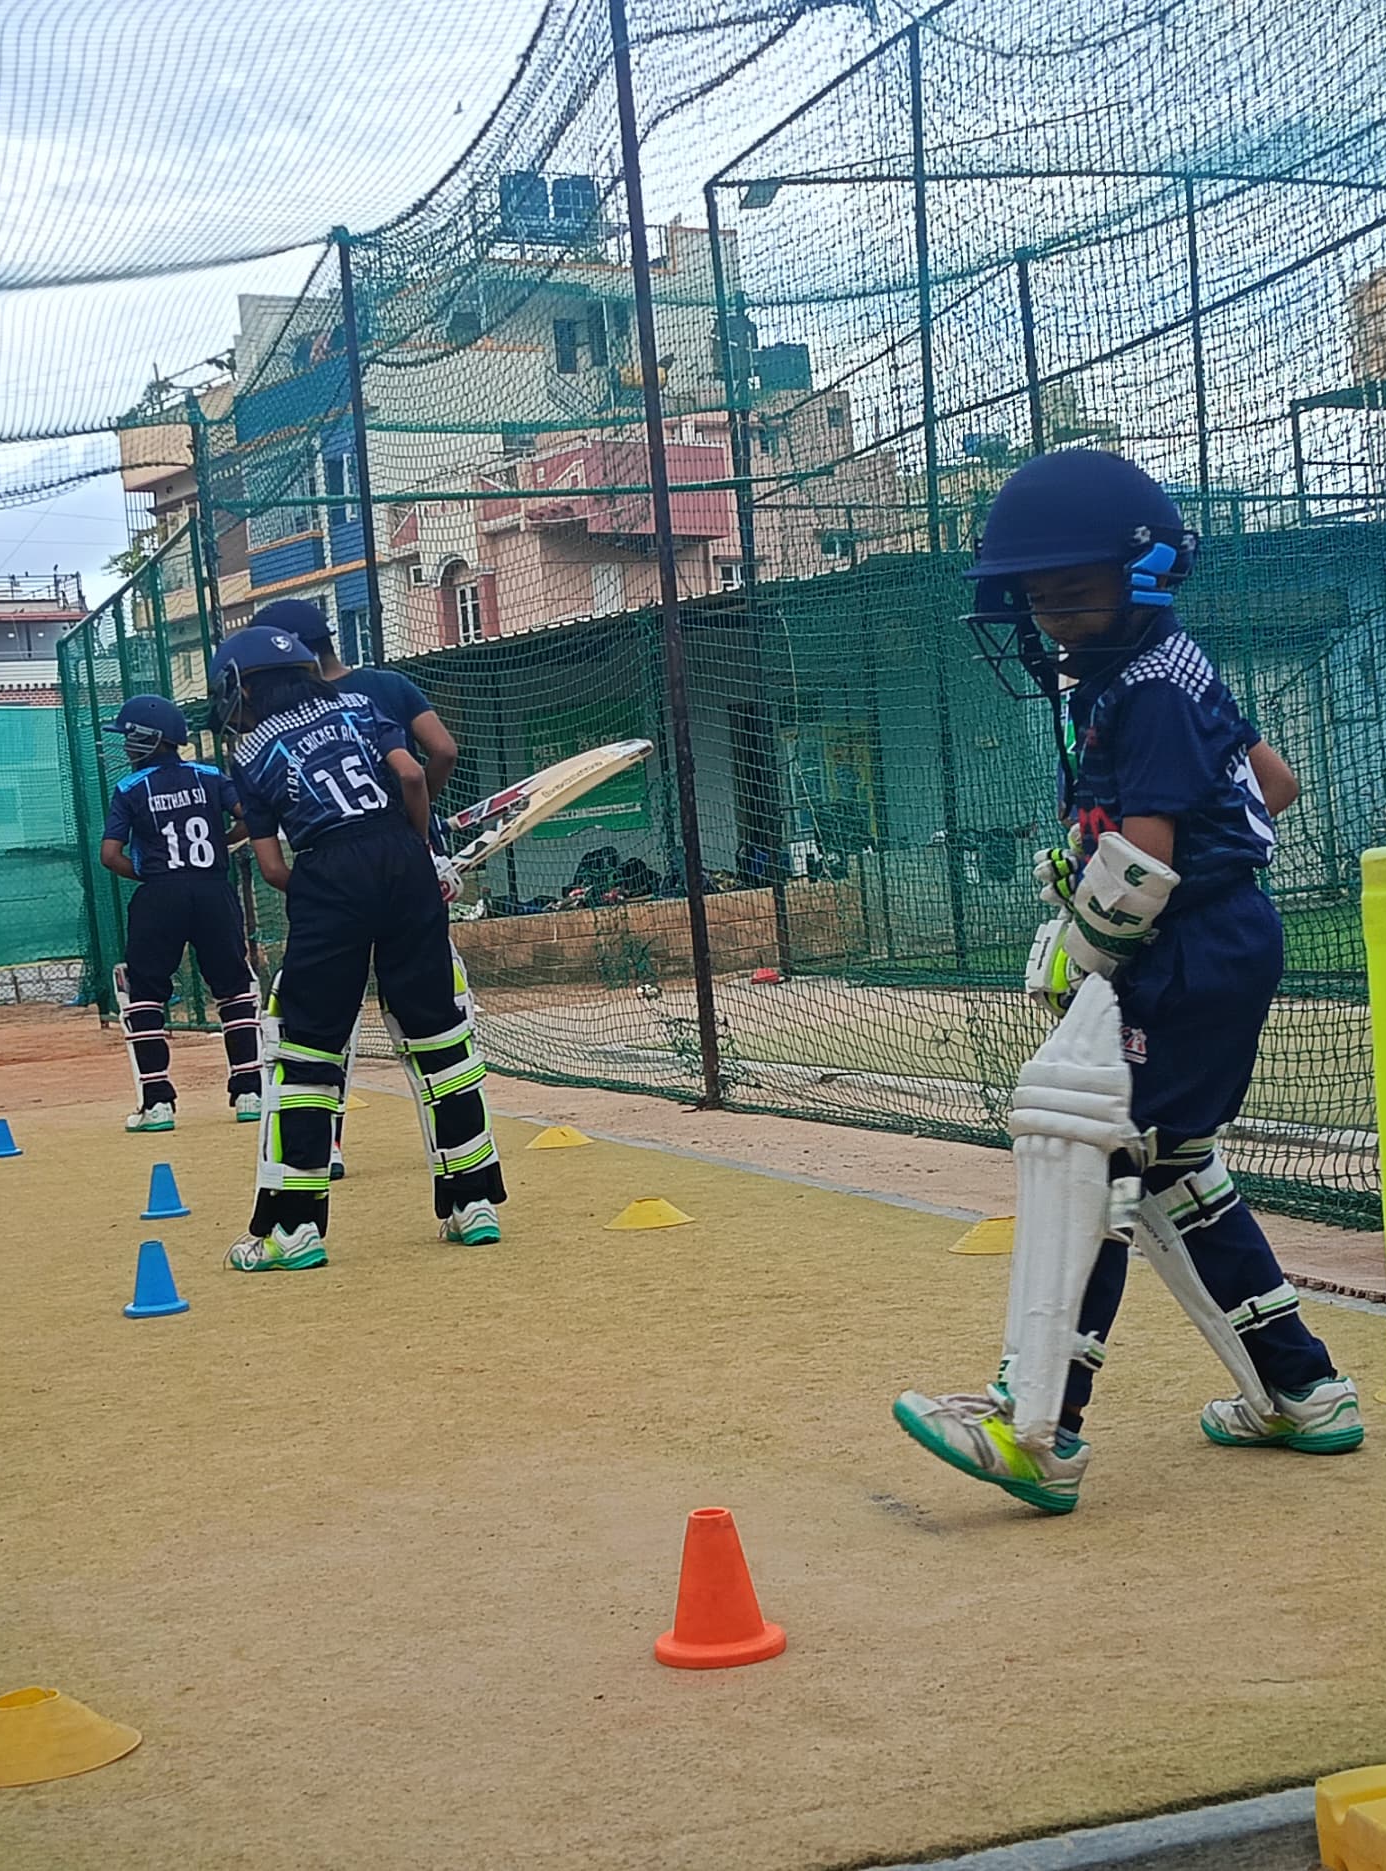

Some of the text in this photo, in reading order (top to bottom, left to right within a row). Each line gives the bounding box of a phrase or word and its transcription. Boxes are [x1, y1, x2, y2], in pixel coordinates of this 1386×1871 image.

[297, 724, 340, 756] CRICKET
[313, 754, 389, 818] 15
[161, 816, 215, 869] 18
